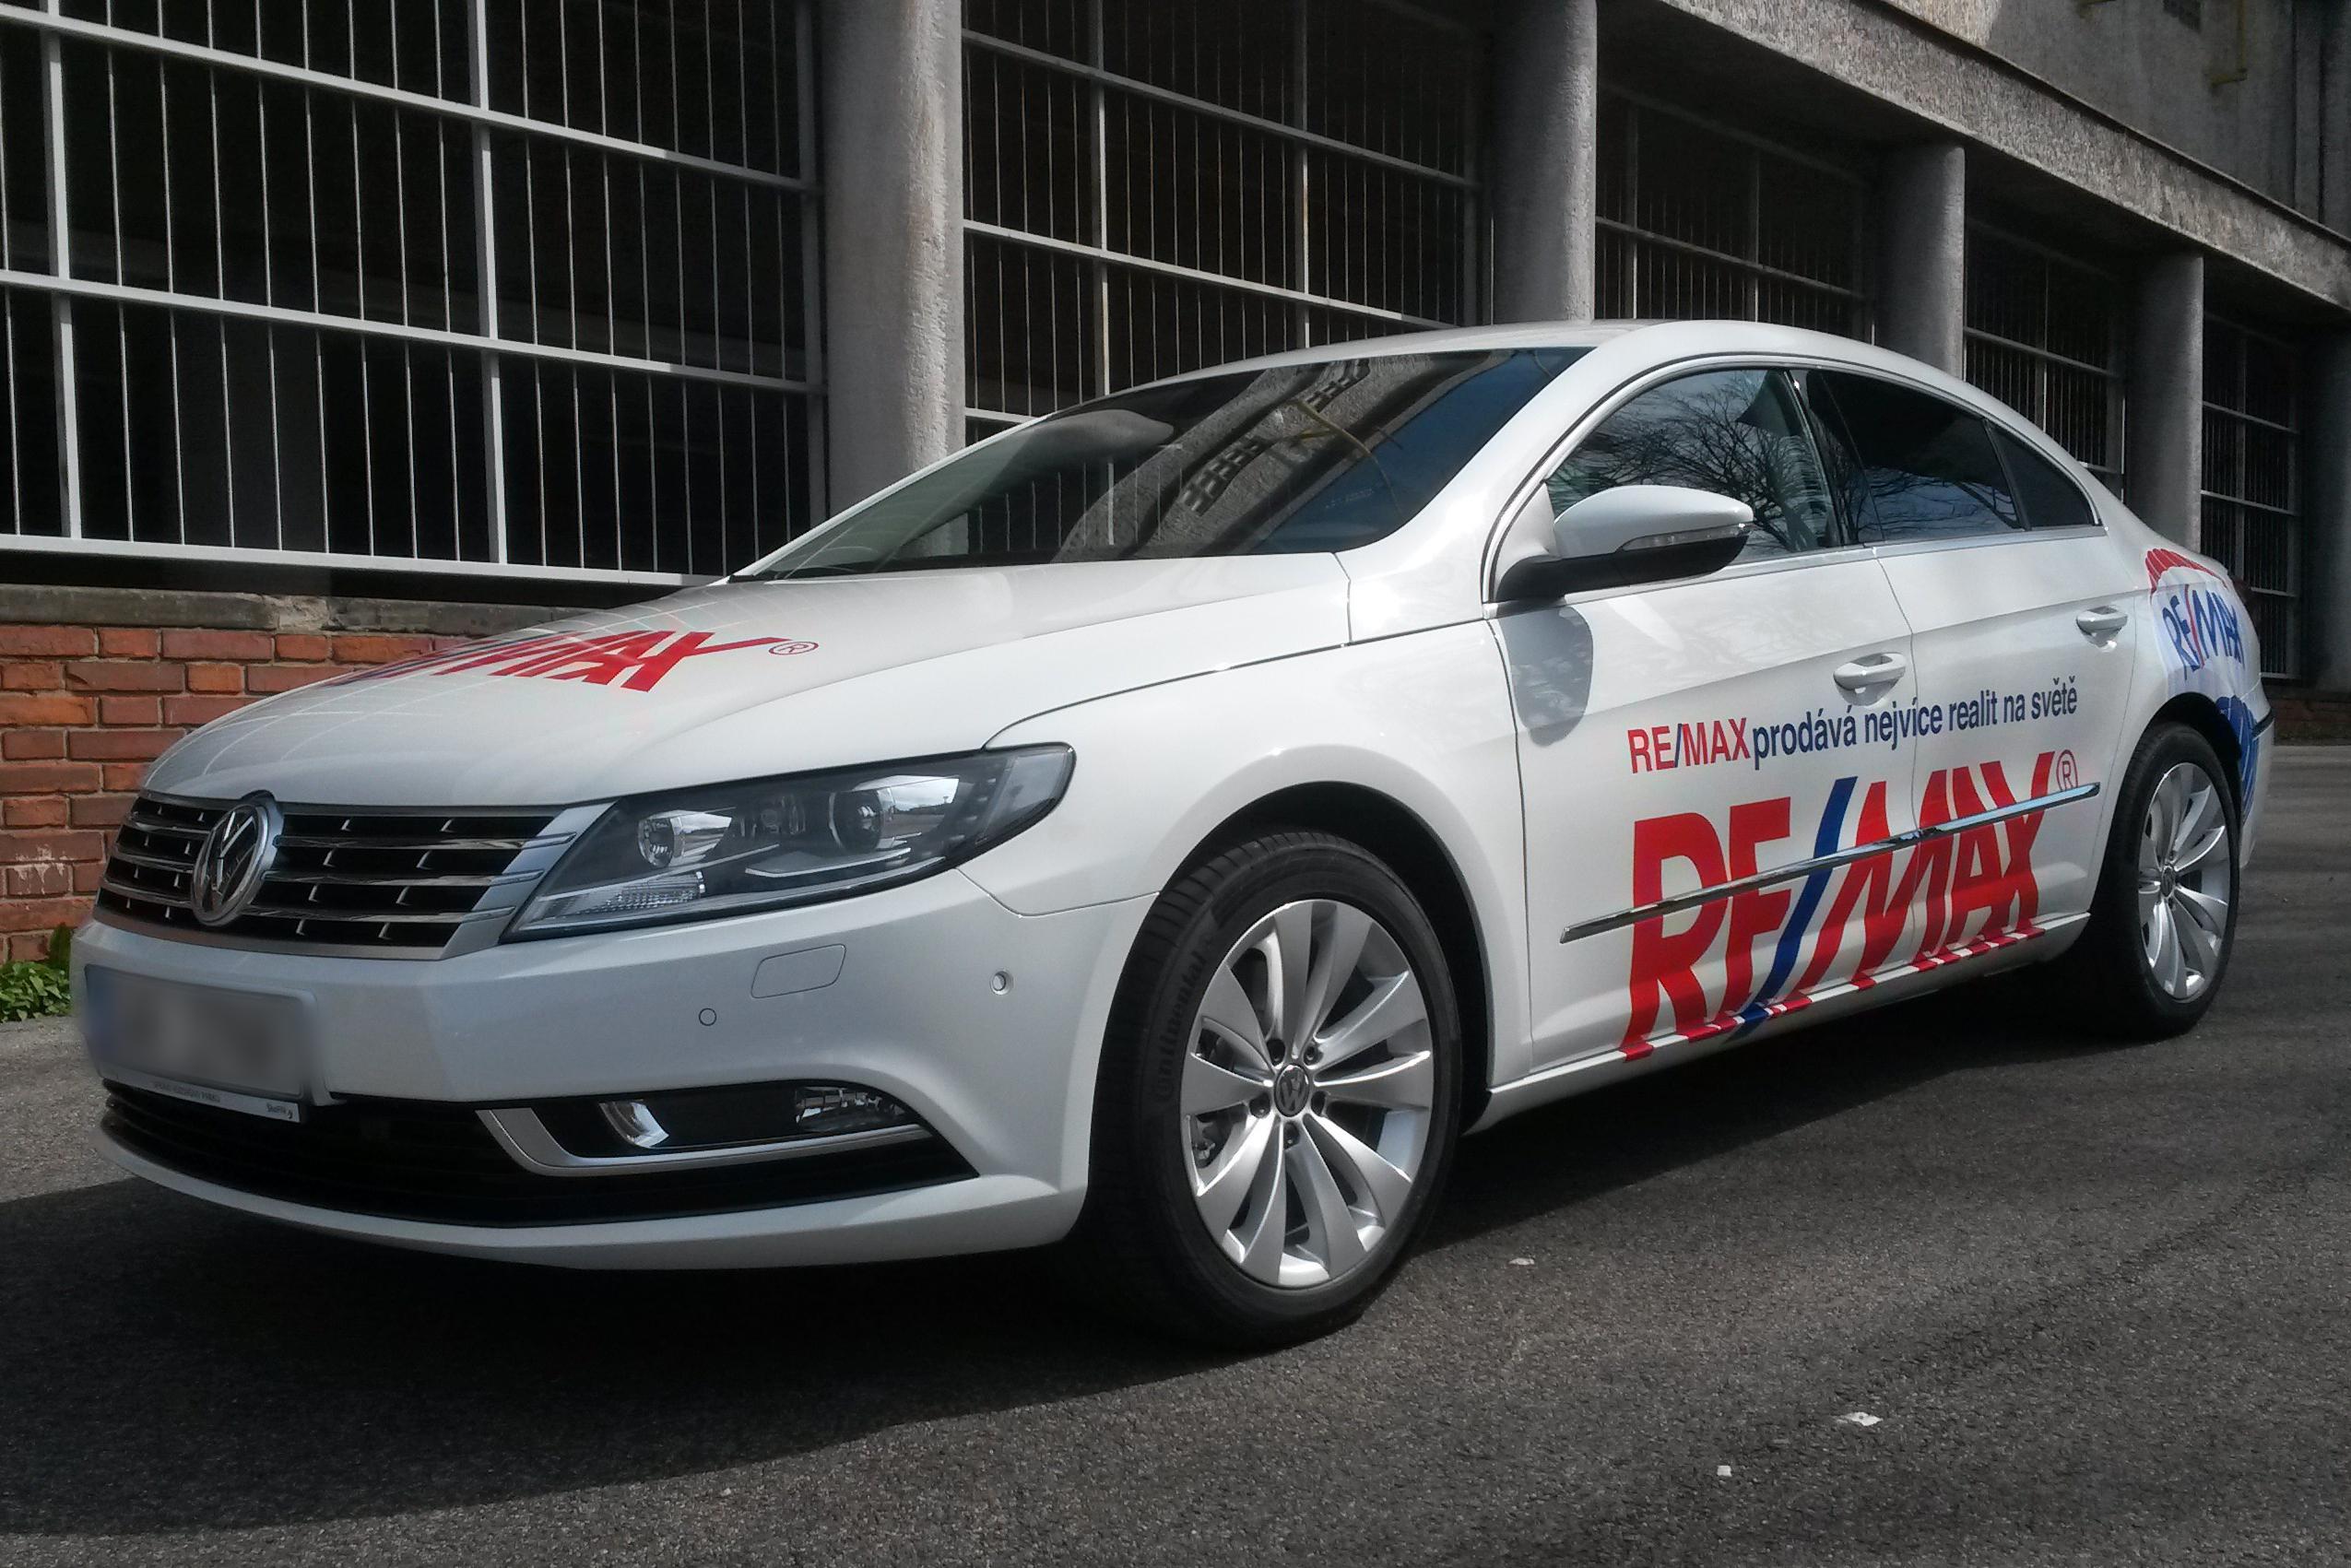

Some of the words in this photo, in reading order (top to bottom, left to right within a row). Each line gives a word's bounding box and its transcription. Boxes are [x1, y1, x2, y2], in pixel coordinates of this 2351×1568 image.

[1627, 717, 1752, 774] RE/MAX
[1752, 703, 1858, 771] prodává
[1864, 698, 1943, 750] nejvíce
[1948, 690, 1999, 733] realit
[2003, 694, 2026, 724] na
[2031, 677, 2078, 721] světě
[1620, 751, 2055, 1061] RE/MAX
